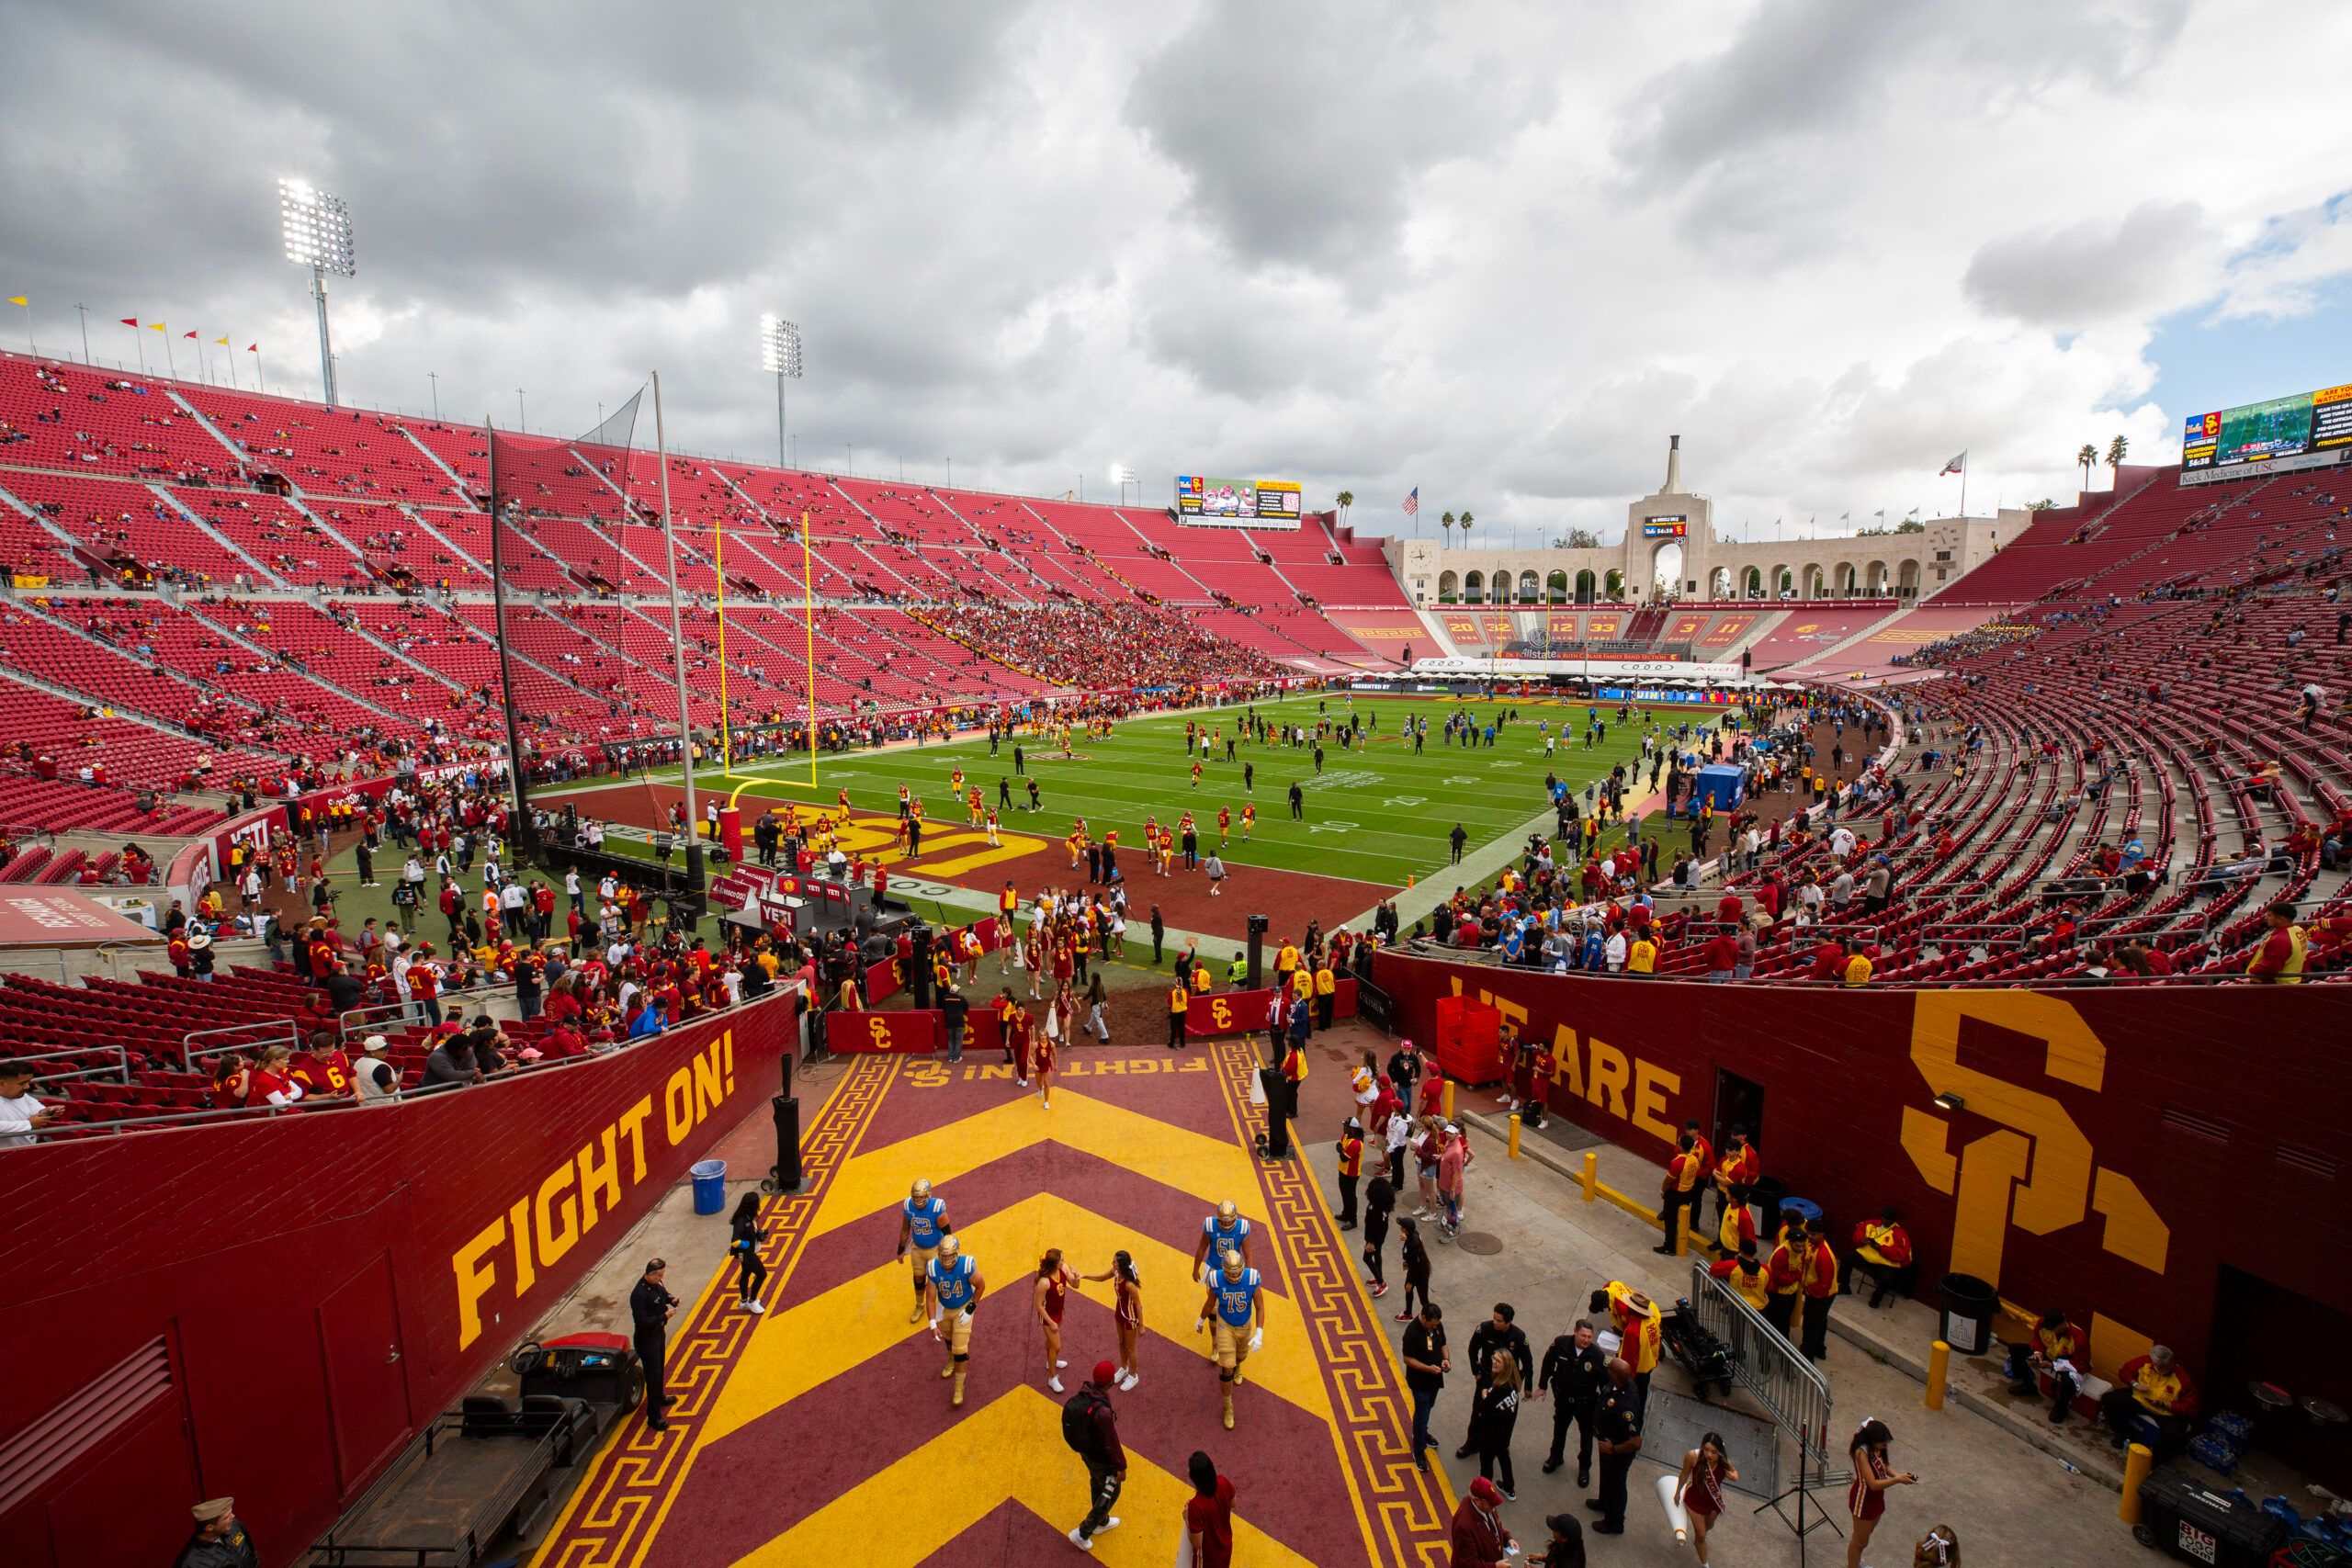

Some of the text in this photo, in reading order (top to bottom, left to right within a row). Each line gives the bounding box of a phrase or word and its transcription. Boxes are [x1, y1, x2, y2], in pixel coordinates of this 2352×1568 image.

[2316, 392, 2352, 403] WATCHIN
[2205, 415, 2218, 434] SC
[2182, 472, 2202, 484] Keck
[2205, 465, 2242, 479] Medicine
[2255, 461, 2277, 473] USC
[1450, 624, 1474, 632] 20
[1487, 624, 1511, 632] 32
[1553, 624, 1573, 632] 12
[1590, 624, 1614, 632] 33
[1679, 624, 1696, 633] 3
[1718, 624, 1740, 633] 11
[1521, 649, 1556, 660] Allstate
[230, 818, 269, 852] YETI
[1309, 820, 1360, 833] 10
[1841, 833, 1852, 843] 42
[807, 884, 820, 894] YETI
[827, 887, 841, 897] YETI
[762, 905, 793, 926] YETI
[407, 975, 423, 989] 21
[1212, 998, 1232, 1029] SC
[869, 1017, 892, 1048] SC
[903, 1059, 953, 1088] SC
[1060, 1057, 1209, 1077] FIGHT
[326, 1066, 345, 1089] 6
[1550, 1022, 1680, 1146] ARE
[449, 1028, 735, 1352] FIGHT ON!
[1216, 1238, 1235, 1257] 61
[939, 1280, 964, 1300] 64
[1223, 1292, 1248, 1313] 75
[2180, 1522, 2214, 1547] BIG
[2179, 1532, 2214, 1557] FOGG
[2181, 1544, 2211, 1561] .com
